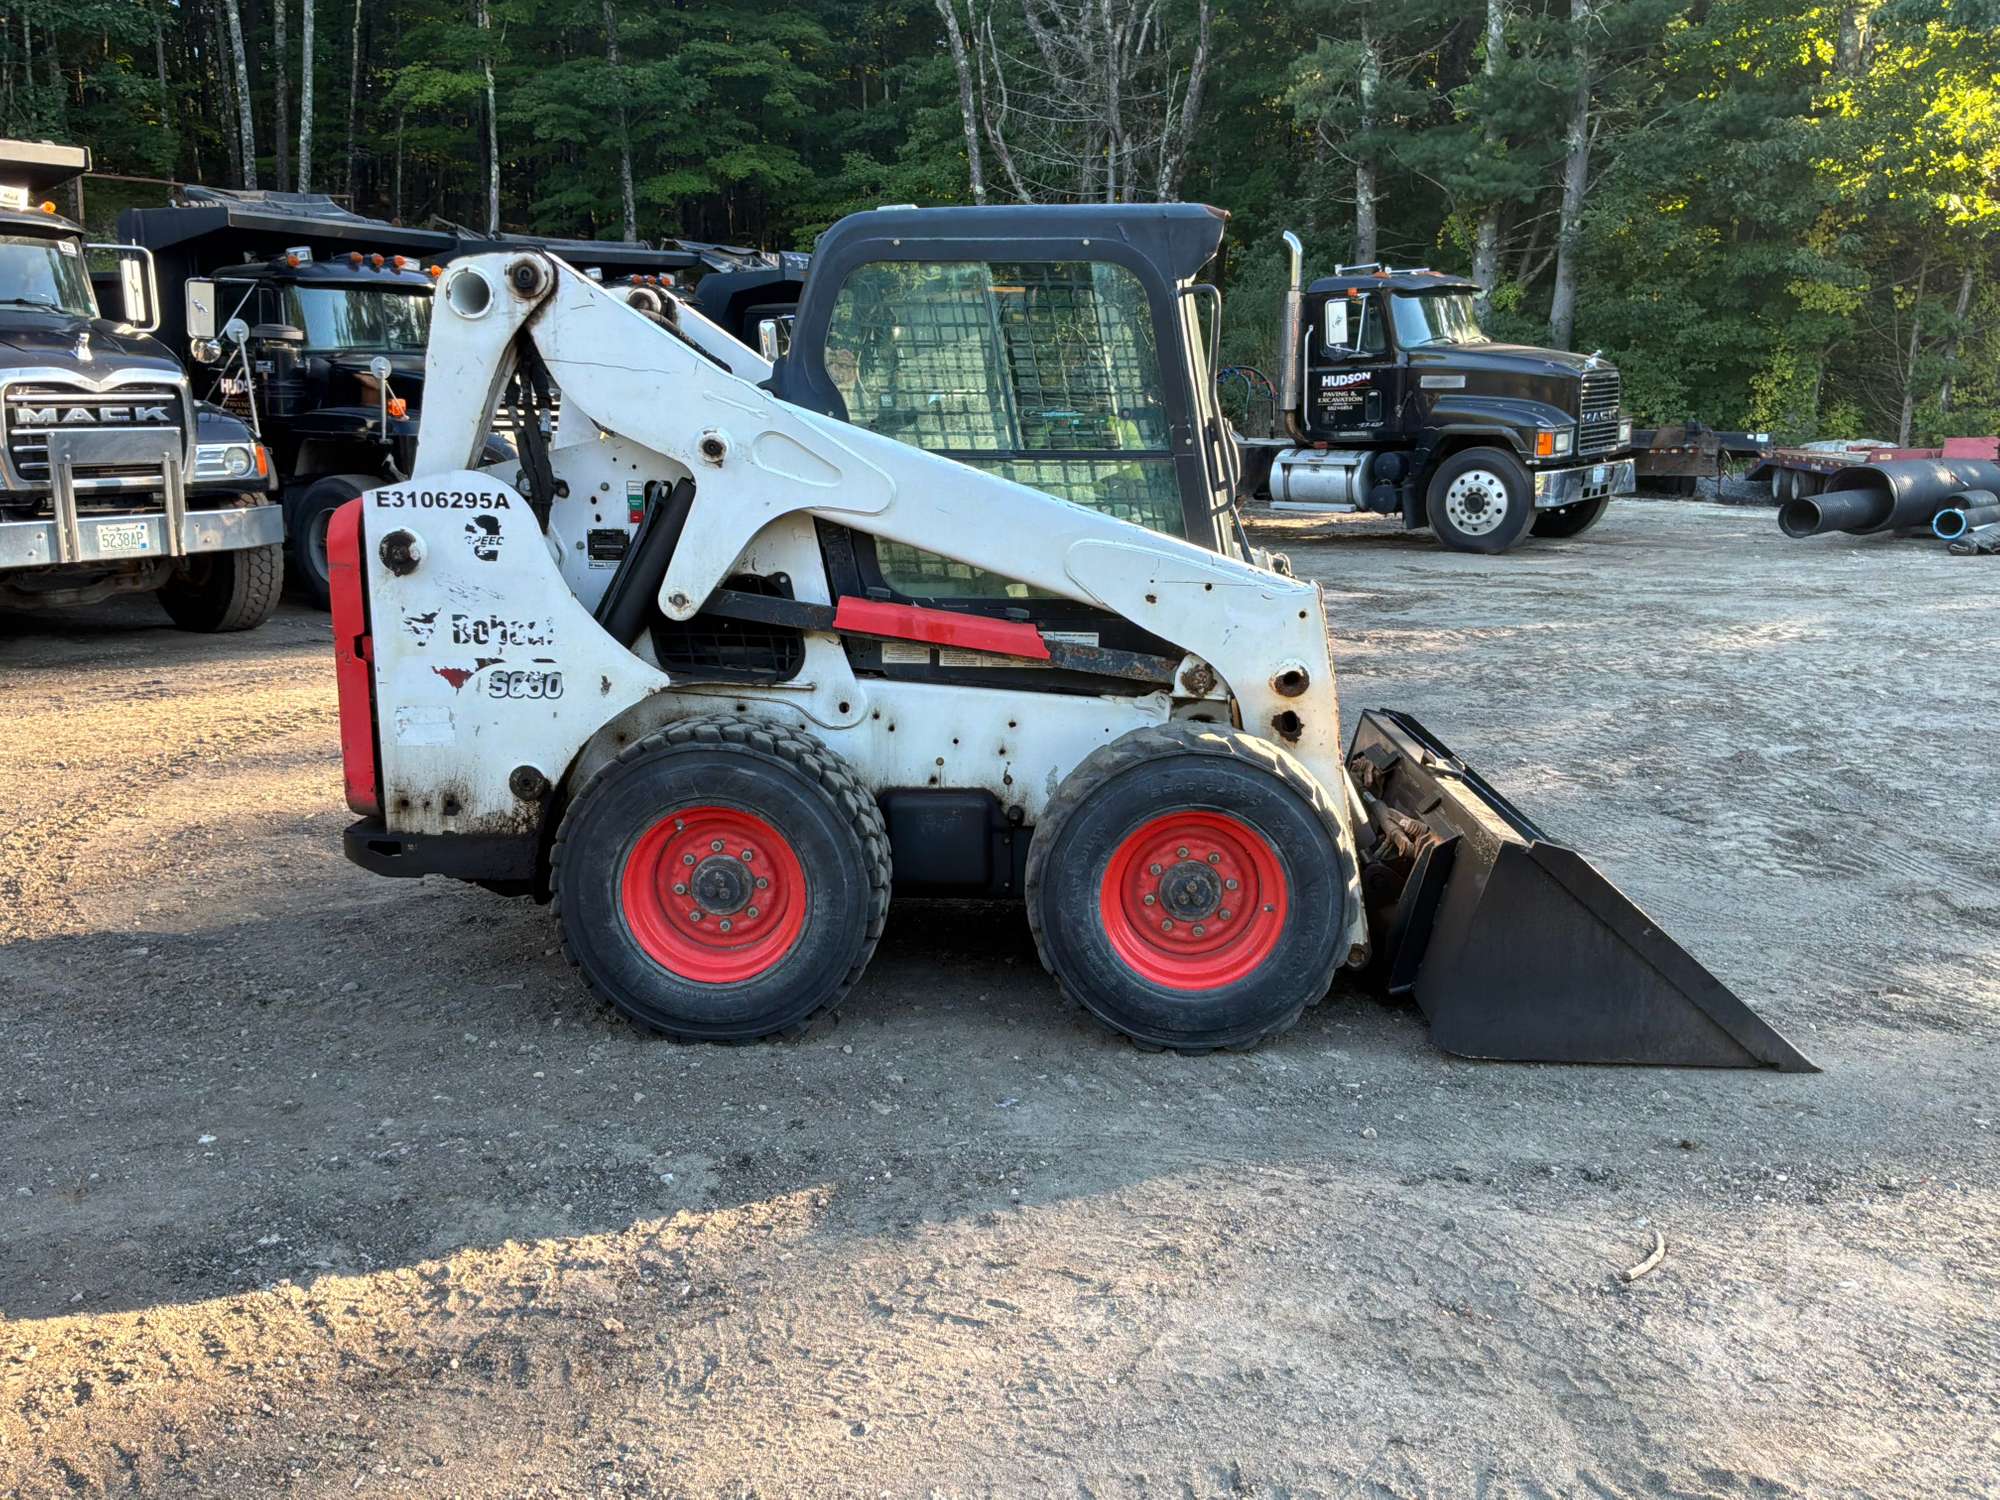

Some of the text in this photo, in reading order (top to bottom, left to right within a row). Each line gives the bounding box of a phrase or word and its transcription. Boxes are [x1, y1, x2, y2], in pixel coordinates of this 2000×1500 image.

[1321, 371, 1372, 387] HUDSON
[1317, 395, 1364, 404] EXCAVATION
[15, 406, 171, 425] MACK
[376, 490, 511, 510] E3106295A
[102, 531, 144, 549] 5238AP
